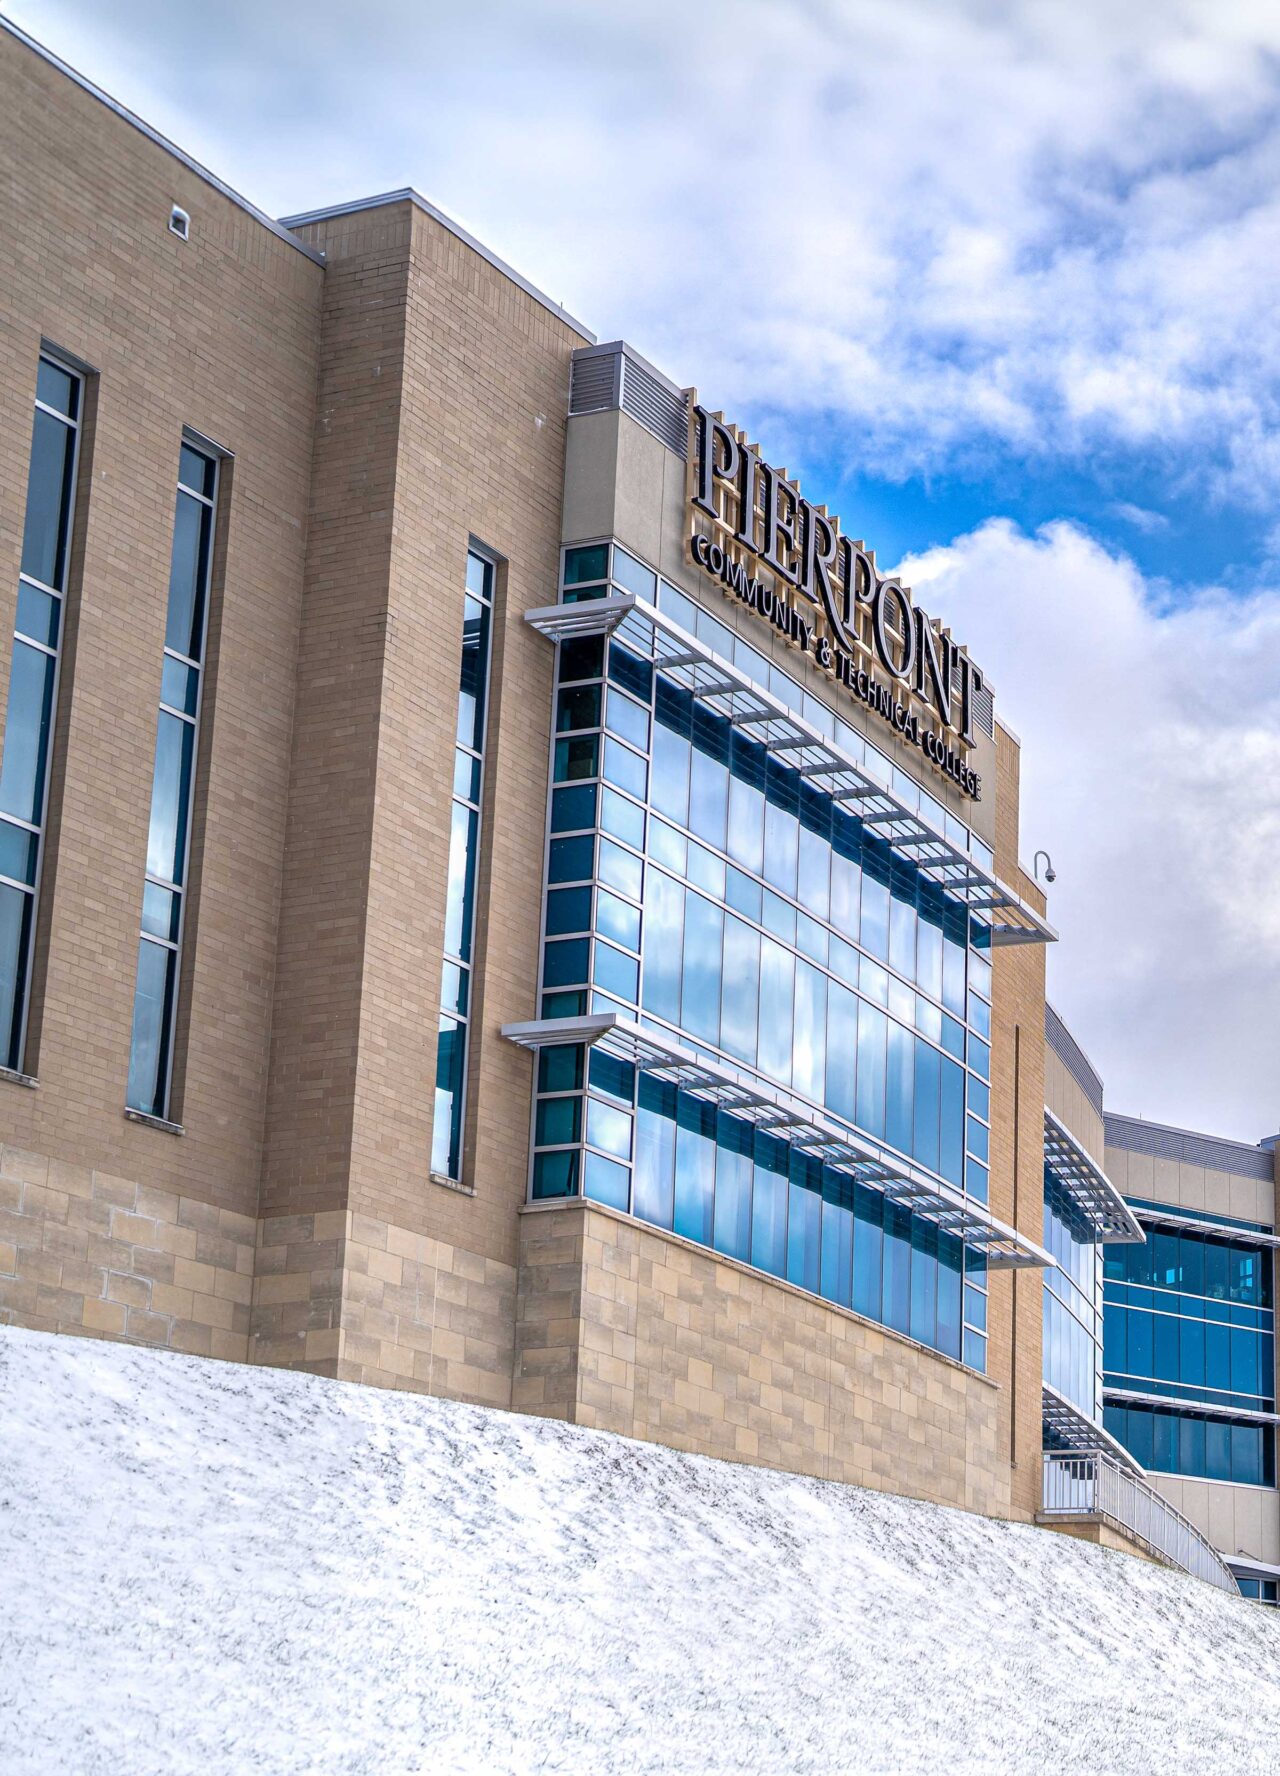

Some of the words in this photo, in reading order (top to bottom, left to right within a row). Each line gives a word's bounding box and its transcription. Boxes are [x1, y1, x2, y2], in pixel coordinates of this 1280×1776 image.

[691, 533, 814, 651] COMMUNITY
[818, 636, 832, 667] &
[835, 649, 921, 745] TECHNICAL
[922, 731, 982, 801] COLLEGE
[692, 405, 983, 748] PIERPONT
